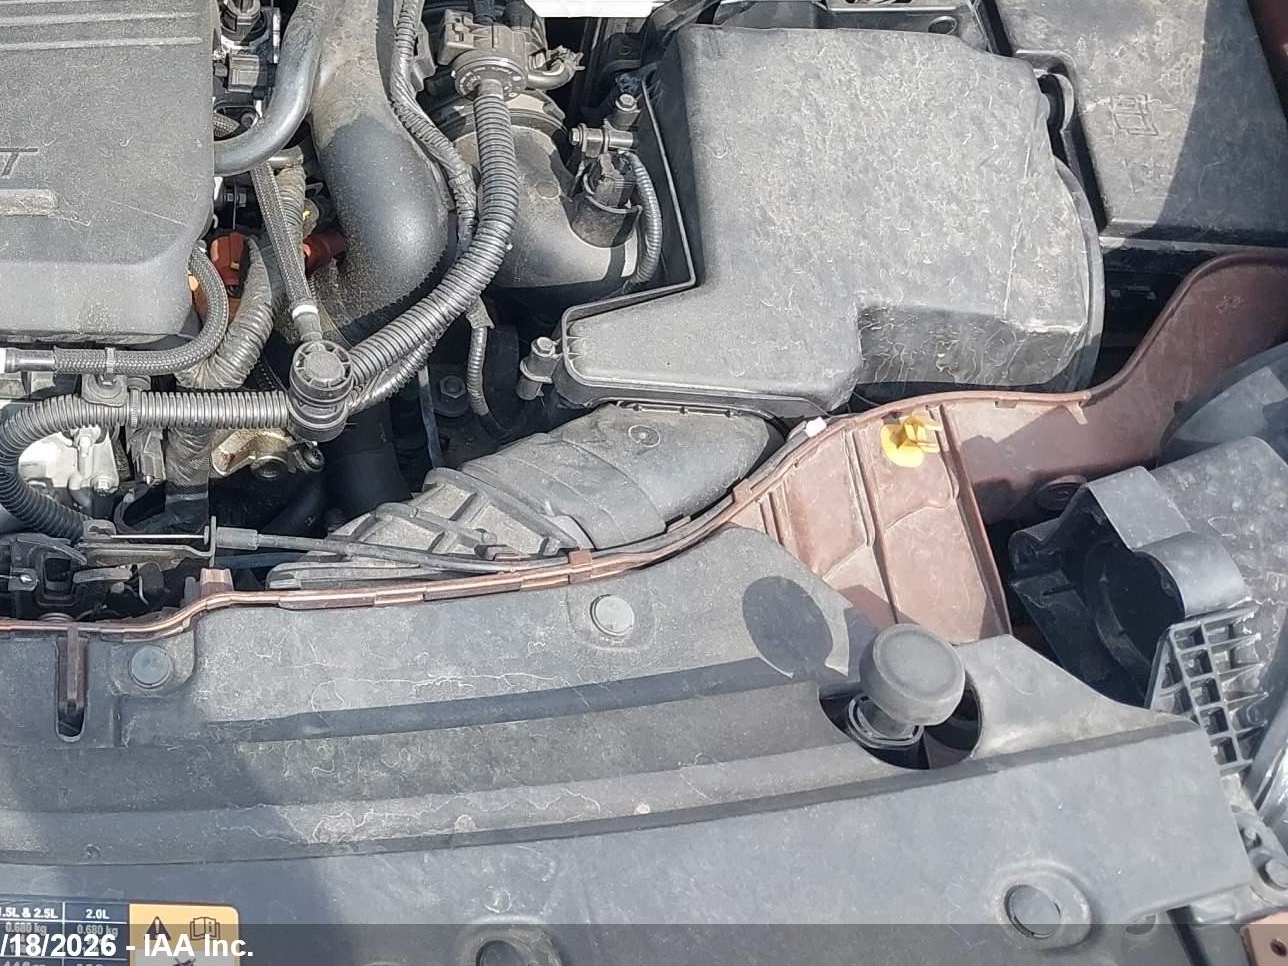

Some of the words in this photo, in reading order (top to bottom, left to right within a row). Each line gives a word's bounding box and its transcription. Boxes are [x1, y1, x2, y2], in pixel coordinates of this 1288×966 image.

[22, 907, 31, 918] &
[33, 908, 58, 919] 2.5L
[85, 909, 110, 919] 2.0L
[5, 922, 32, 933] 0.680
[34, 923, 47, 935] kg
[76, 924, 103, 935] 0.680
